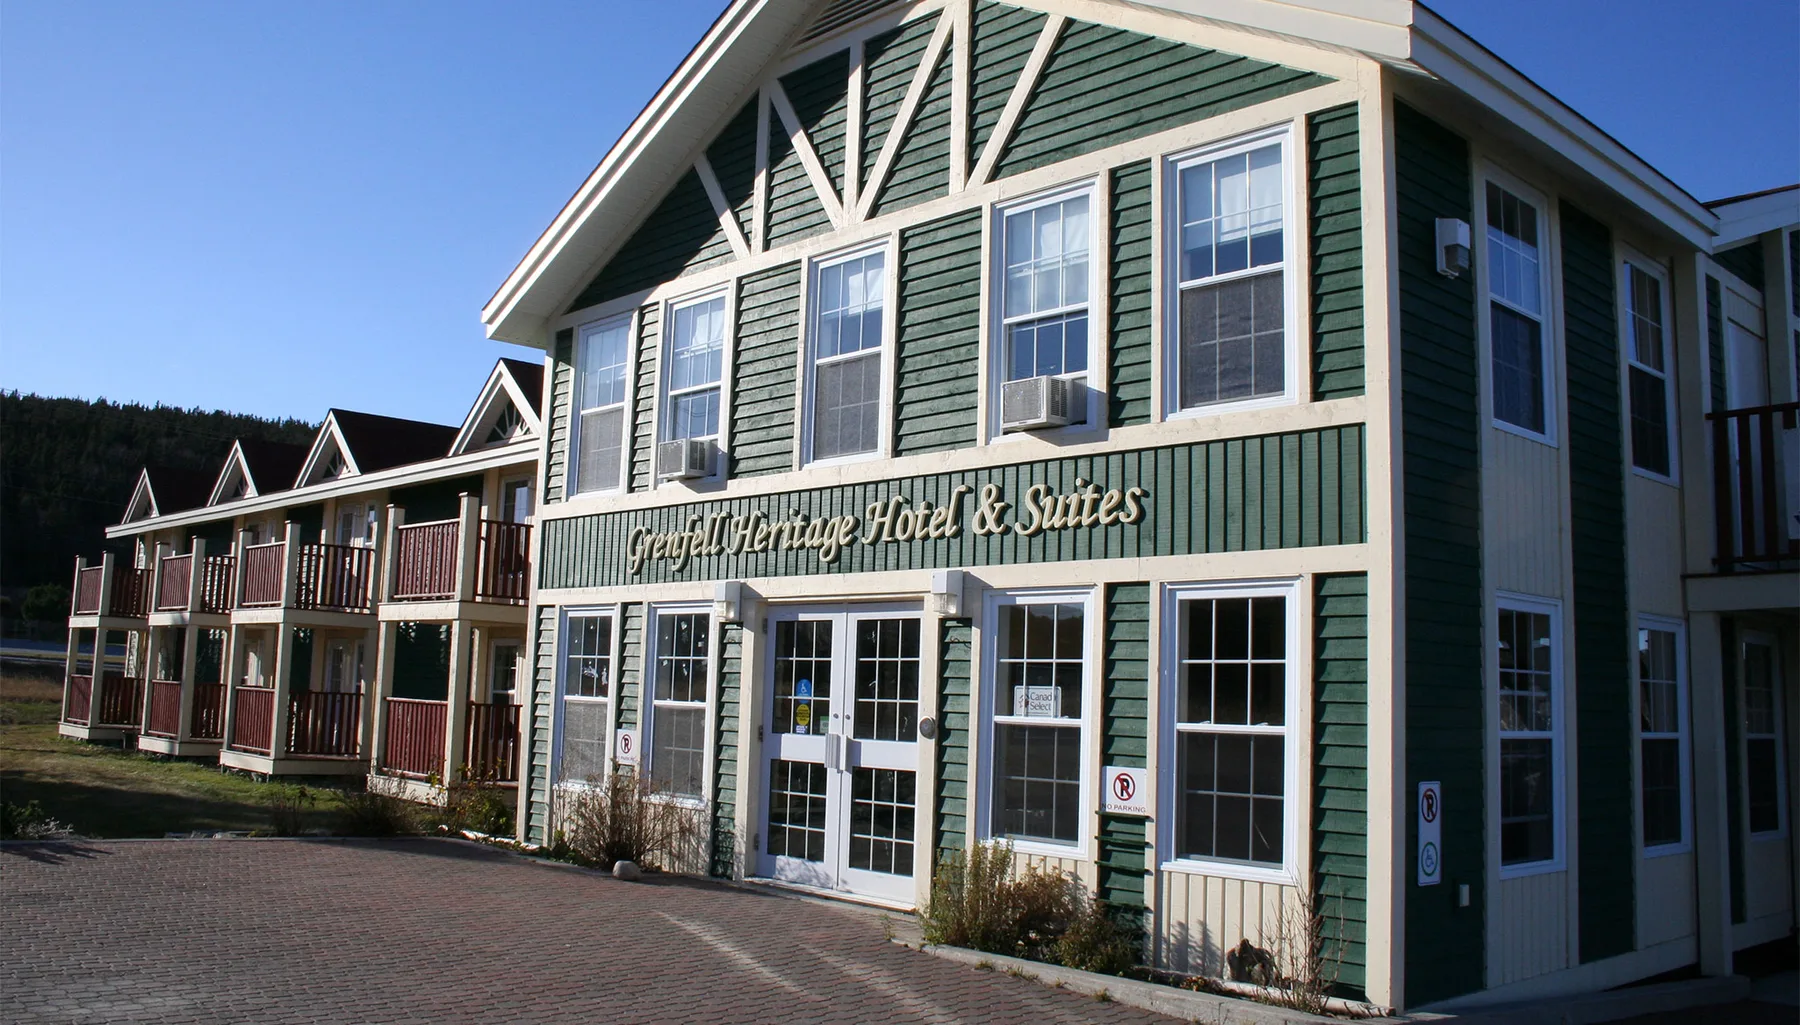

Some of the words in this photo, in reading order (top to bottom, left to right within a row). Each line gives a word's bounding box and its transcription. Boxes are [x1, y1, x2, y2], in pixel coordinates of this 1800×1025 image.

[627, 511, 729, 574] Grenfell
[728, 508, 856, 562] Heritage
[861, 484, 969, 545] Hotel
[972, 483, 1007, 535] &
[1015, 477, 1144, 536] Suites
[1030, 691, 1057, 702] Canad
[1030, 701, 1052, 711] Select
[1113, 804, 1147, 813] PARKING
